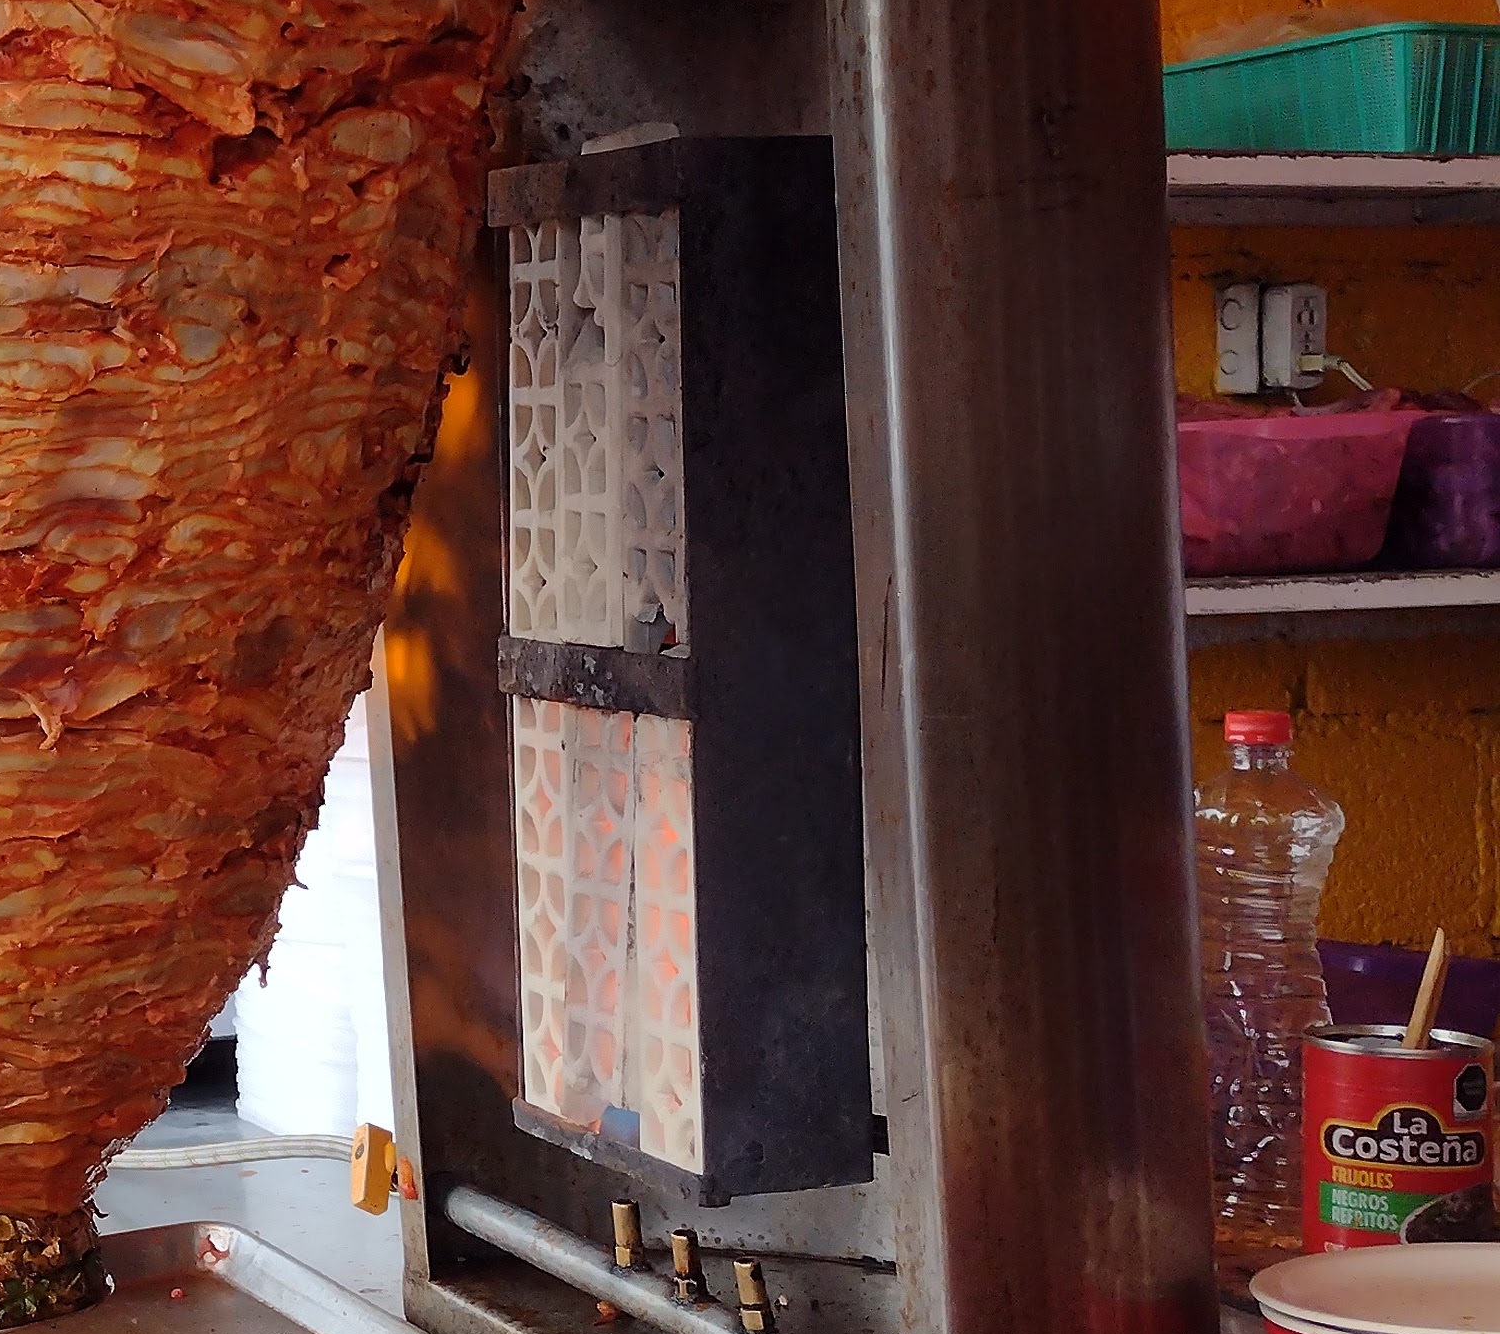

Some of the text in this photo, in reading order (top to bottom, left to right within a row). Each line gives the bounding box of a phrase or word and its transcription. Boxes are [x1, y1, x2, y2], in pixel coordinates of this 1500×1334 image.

[1393, 1112, 1428, 1135] La
[1332, 1128, 1478, 1164] Costeña
[1332, 1165, 1394, 1189] FRIJOLES
[1332, 1188, 1389, 1212] NEGROS
[1332, 1206, 1399, 1231] REFRITOS
